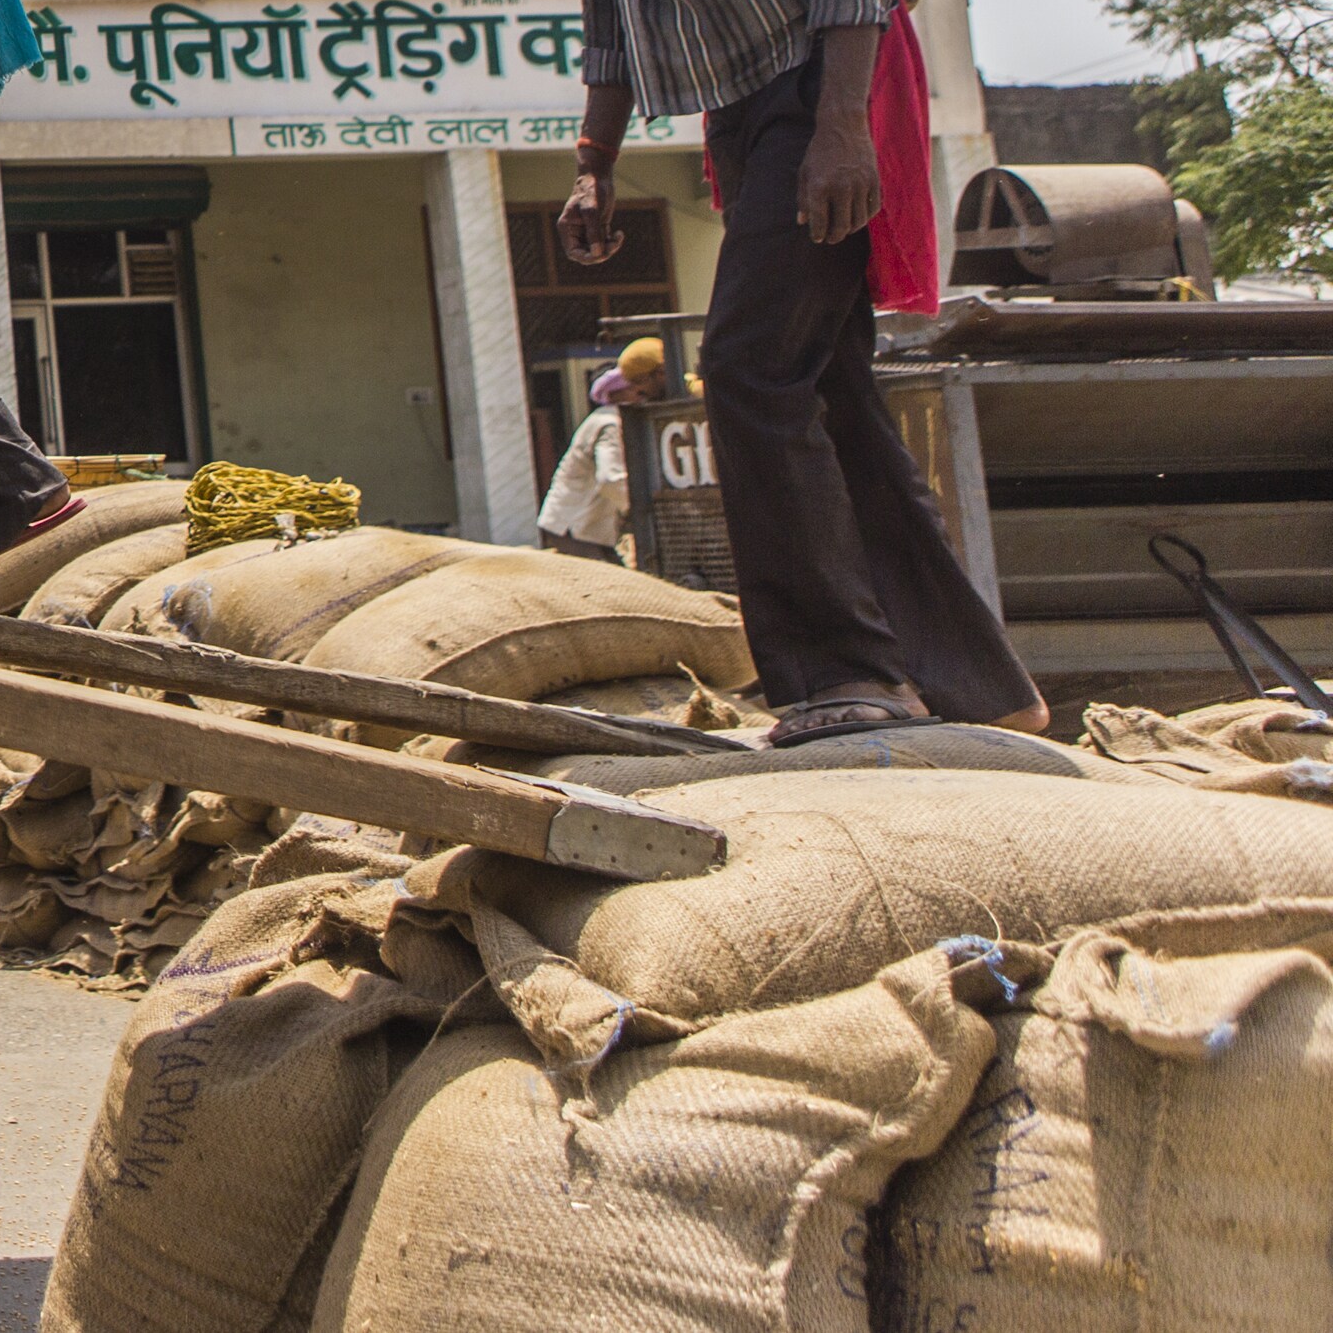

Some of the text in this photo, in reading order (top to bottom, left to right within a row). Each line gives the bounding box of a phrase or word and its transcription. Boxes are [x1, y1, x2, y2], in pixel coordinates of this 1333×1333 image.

[262, 122, 327, 149] ताऊ
[336, 116, 414, 148] देवी
[426, 118, 510, 145] लाल
